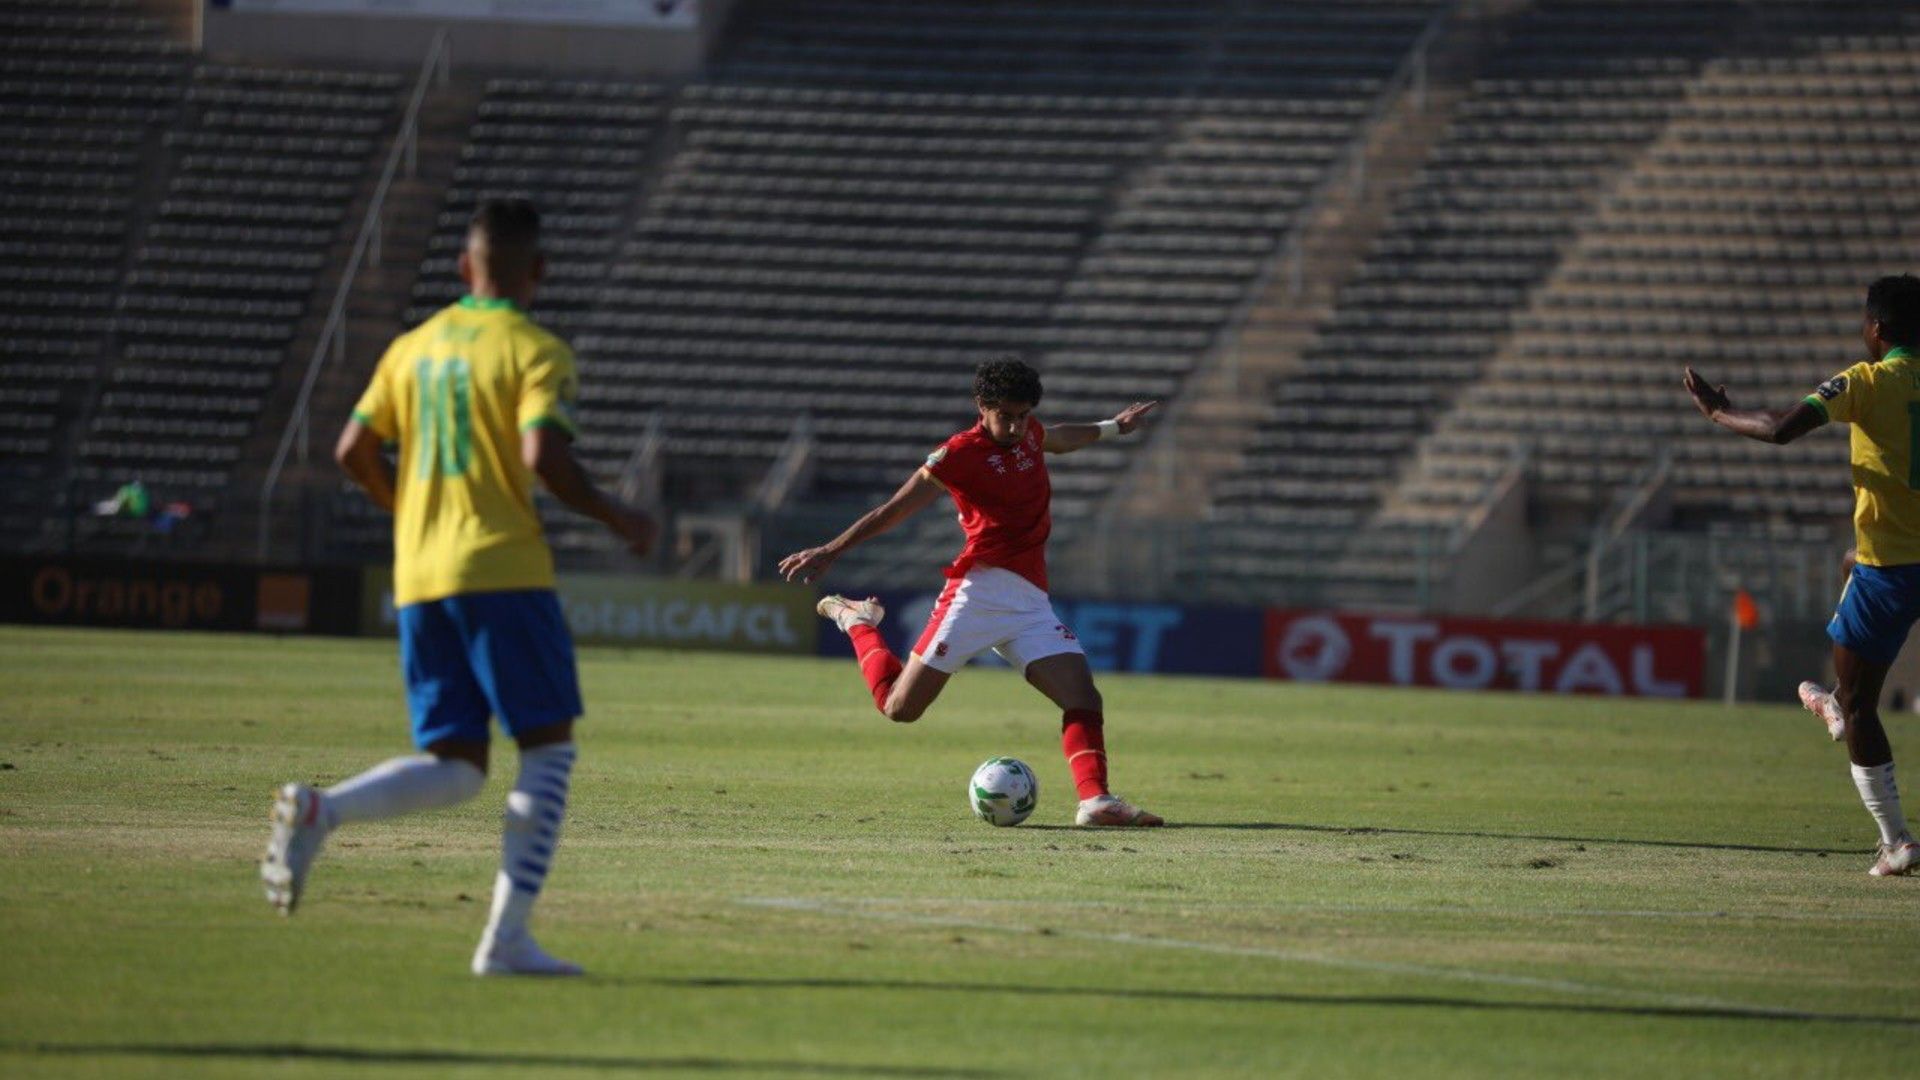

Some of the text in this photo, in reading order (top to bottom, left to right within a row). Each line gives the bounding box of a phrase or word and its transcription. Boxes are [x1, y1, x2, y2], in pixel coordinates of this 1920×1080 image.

[416, 356, 473, 481] 10
[32, 565, 223, 624] Orange
[1368, 621, 1687, 698] TOTAL
